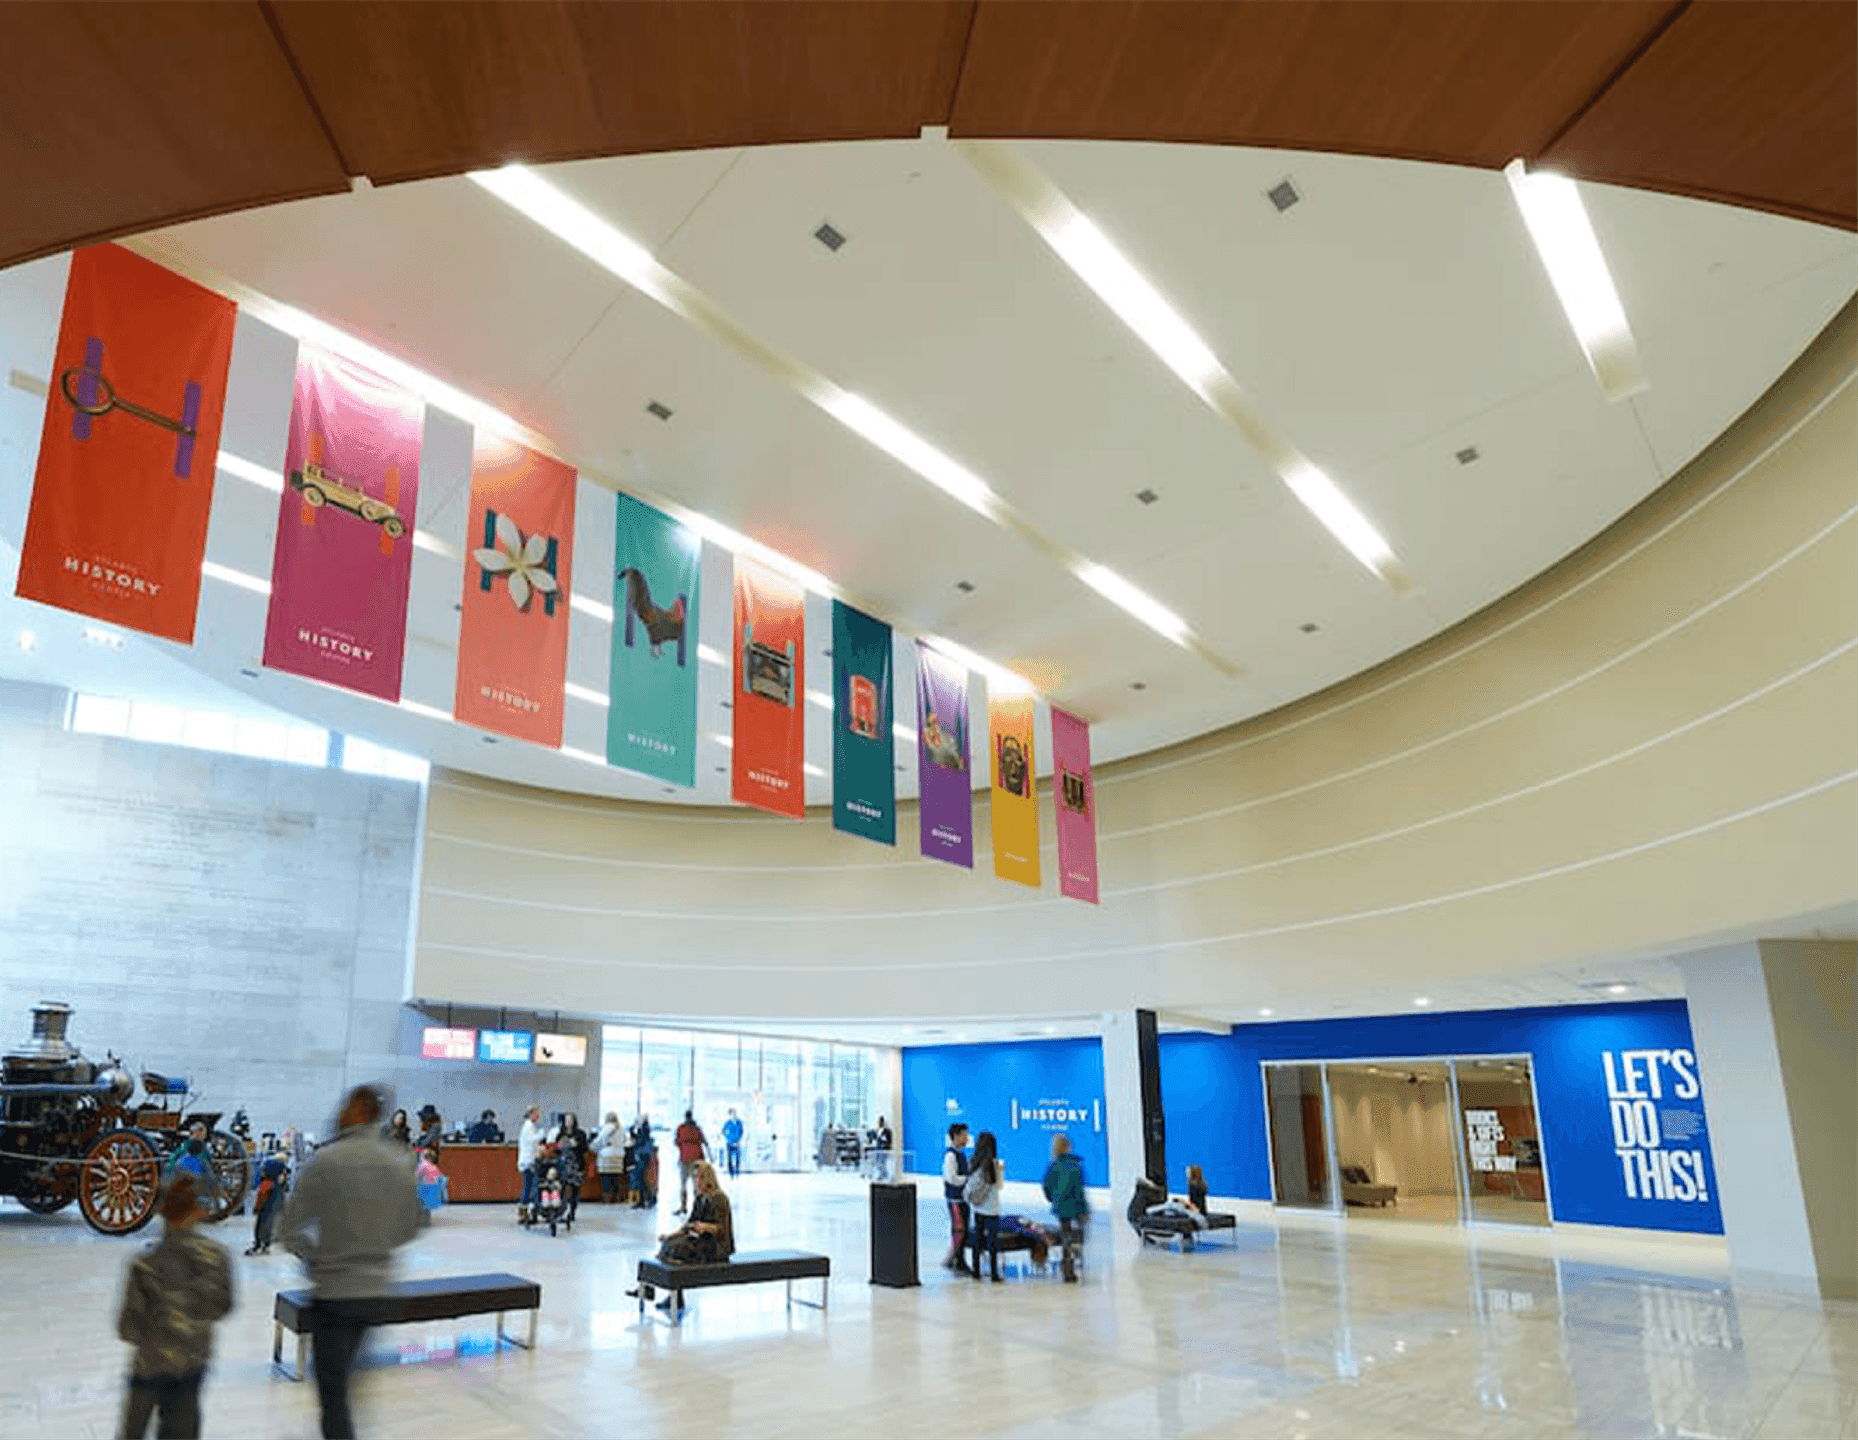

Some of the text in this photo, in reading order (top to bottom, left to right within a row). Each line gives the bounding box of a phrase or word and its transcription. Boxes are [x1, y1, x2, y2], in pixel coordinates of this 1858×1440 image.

[63, 555, 161, 597] HISTORY
[298, 629, 375, 662] HISTORY
[480, 686, 541, 713] HISTORY
[1602, 1049, 1699, 1100] LET'S
[1020, 1108, 1089, 1123] HISTORY
[1610, 1100, 1661, 1149] DO
[1615, 1149, 1709, 1202] THIS!
